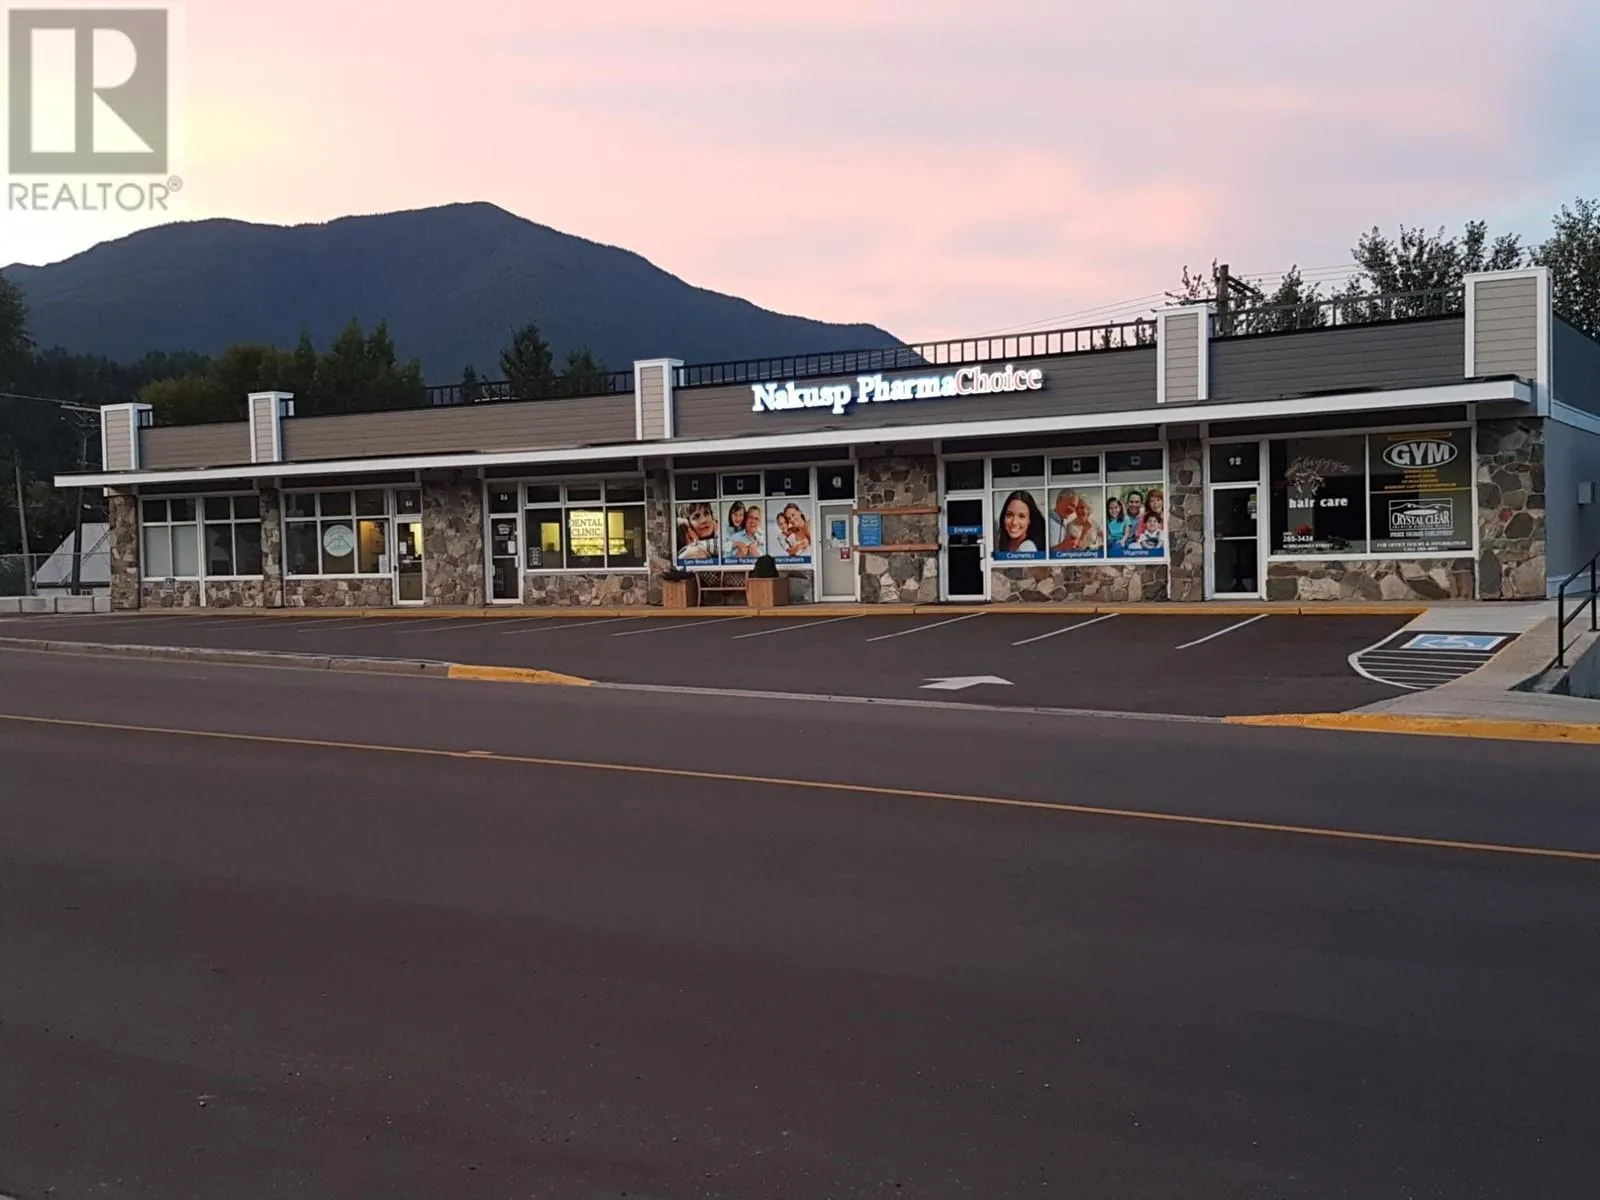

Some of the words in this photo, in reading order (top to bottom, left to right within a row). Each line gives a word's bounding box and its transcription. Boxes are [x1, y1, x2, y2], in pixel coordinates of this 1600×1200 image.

[751, 382, 851, 415] Nakusp
[856, 363, 1043, 404] PharmaChoice
[1390, 442, 1450, 465] GYM
[1288, 498, 1316, 509] hair
[1319, 497, 1349, 507] care
[568, 518, 604, 527] DENTAL
[1391, 512, 1423, 526] CRYSTAL
[1424, 510, 1450, 525] CLEAR
[572, 527, 601, 537] CLINIC
[1056, 551, 1099, 559] Compounding
